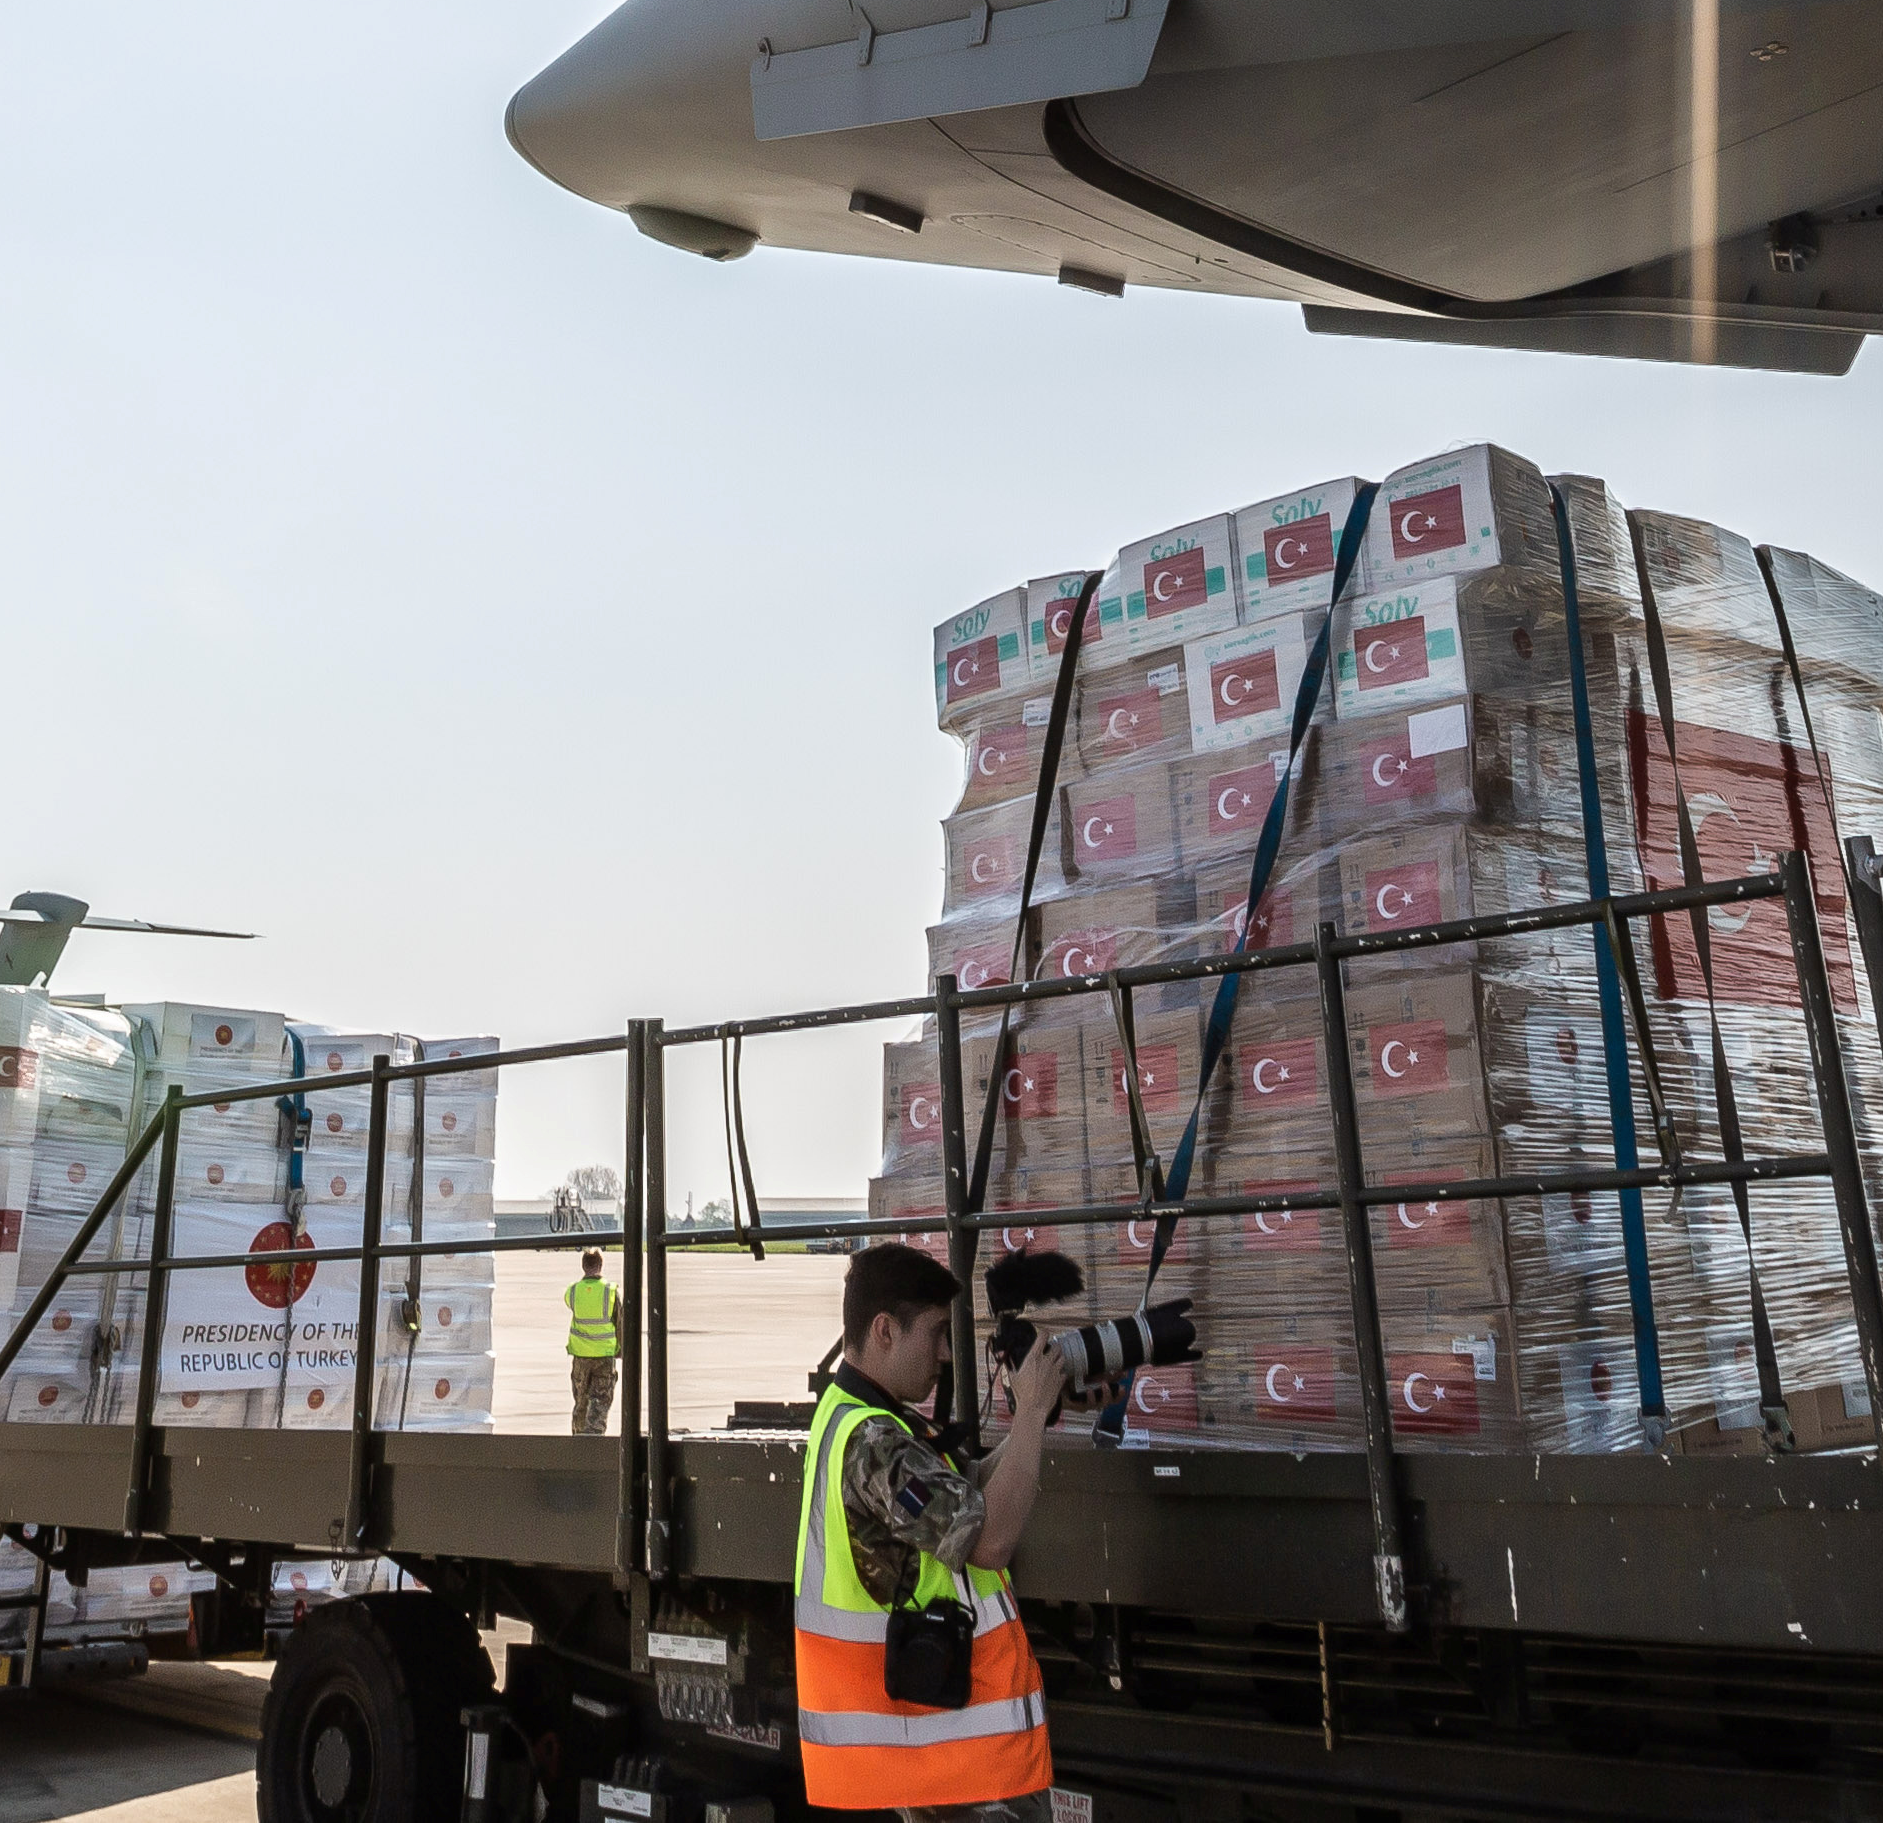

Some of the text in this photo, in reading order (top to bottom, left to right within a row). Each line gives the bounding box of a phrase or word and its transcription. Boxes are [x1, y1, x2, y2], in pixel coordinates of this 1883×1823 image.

[182, 1323, 297, 1344] PRESIDENCY
[302, 1323, 327, 1341] OF
[180, 1351, 264, 1373] REPUBLIC
[296, 1349, 358, 1368] TURKEY
